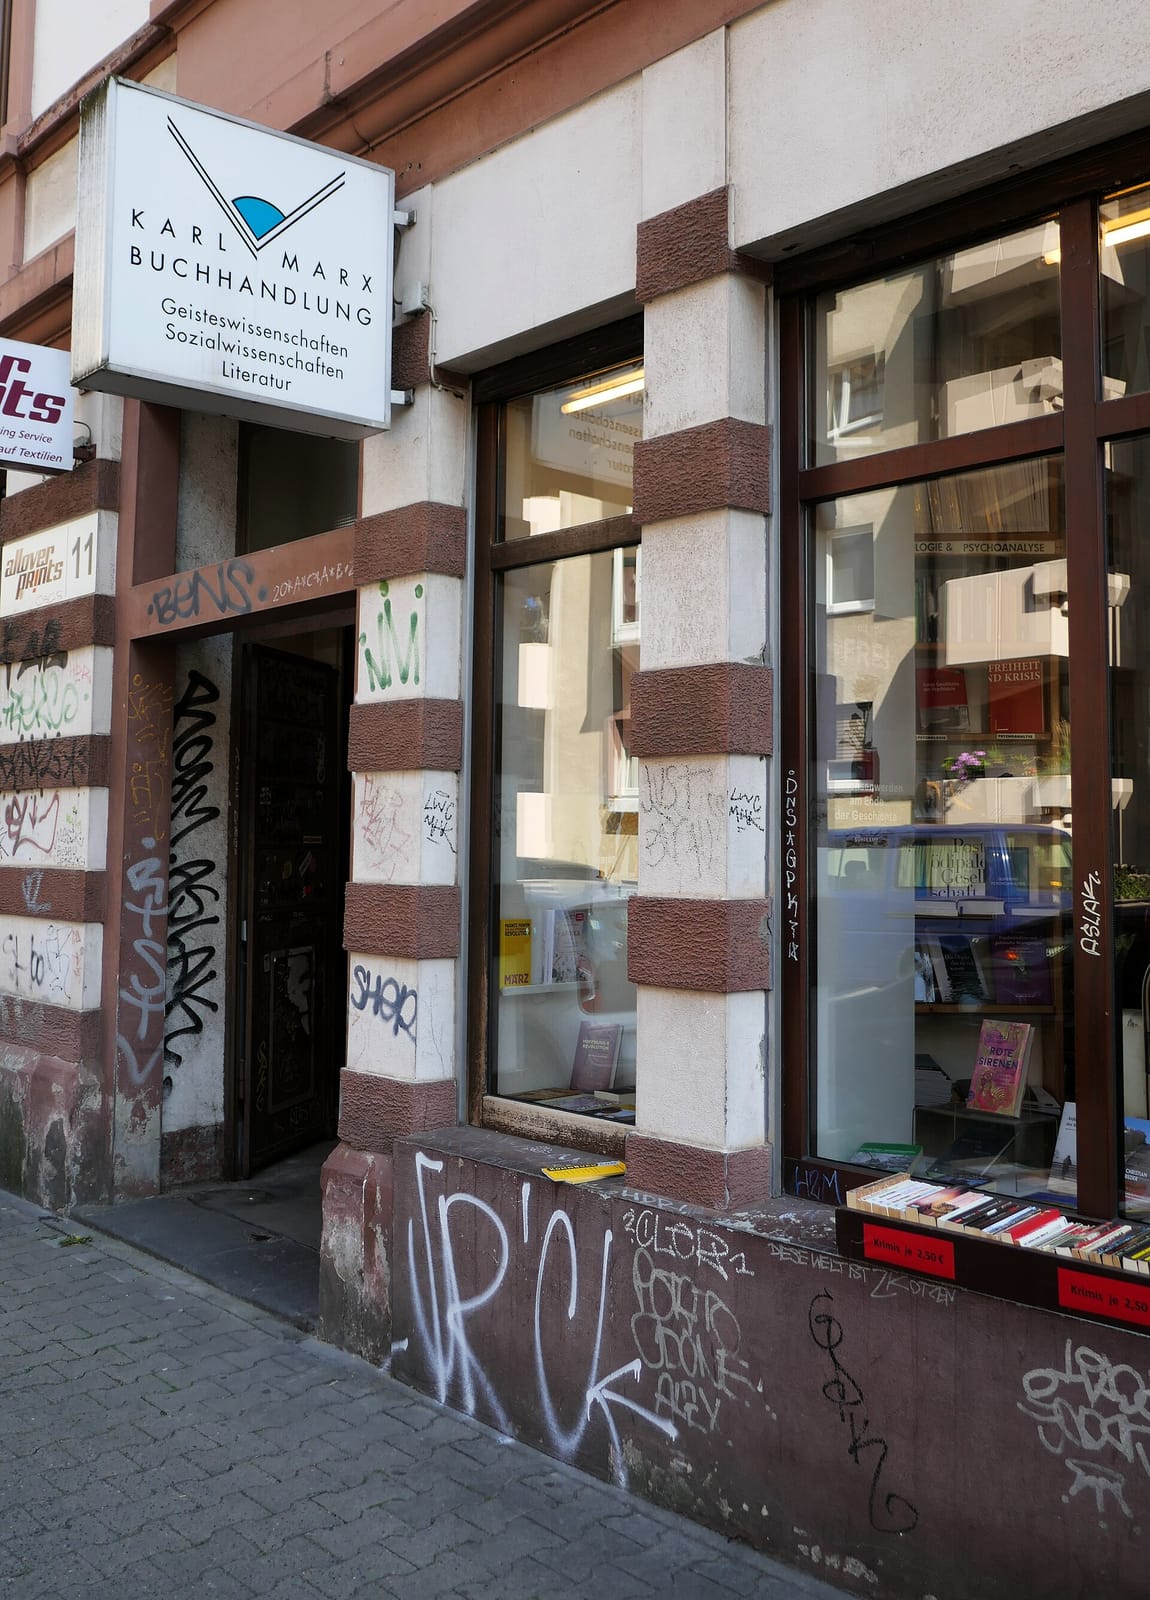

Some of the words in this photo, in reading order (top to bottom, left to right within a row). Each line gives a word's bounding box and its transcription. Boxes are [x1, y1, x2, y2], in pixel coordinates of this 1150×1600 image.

[131, 208, 227, 251] KARL
[282, 251, 373, 293] MARX
[130, 246, 373, 326] BUCHHANDLUNG
[161, 297, 349, 359] Geisteswissenschaften
[165, 323, 345, 380] Sozialwissenschaften
[222, 360, 292, 391] Literatur
[18, 430, 53, 443] Service
[20, 447, 63, 463] Textilien
[5, 545, 55, 577] allover
[72, 532, 93, 579] 11
[963, 543, 1045, 553] PSYCHOANALYSE
[988, 660, 1041, 673] FREIHEIT
[1005, 671, 1041, 682] KRISIS
[504, 973, 529, 985] MÄRZ
[989, 1047, 1015, 1058] ROTE
[978, 1056, 1019, 1070] SIRENEN
[873, 1238, 900, 1254] Krimis
[904, 1245, 913, 1257] je
[1071, 1284, 1103, 1301] Krimis
[1109, 1295, 1118, 1307] je
